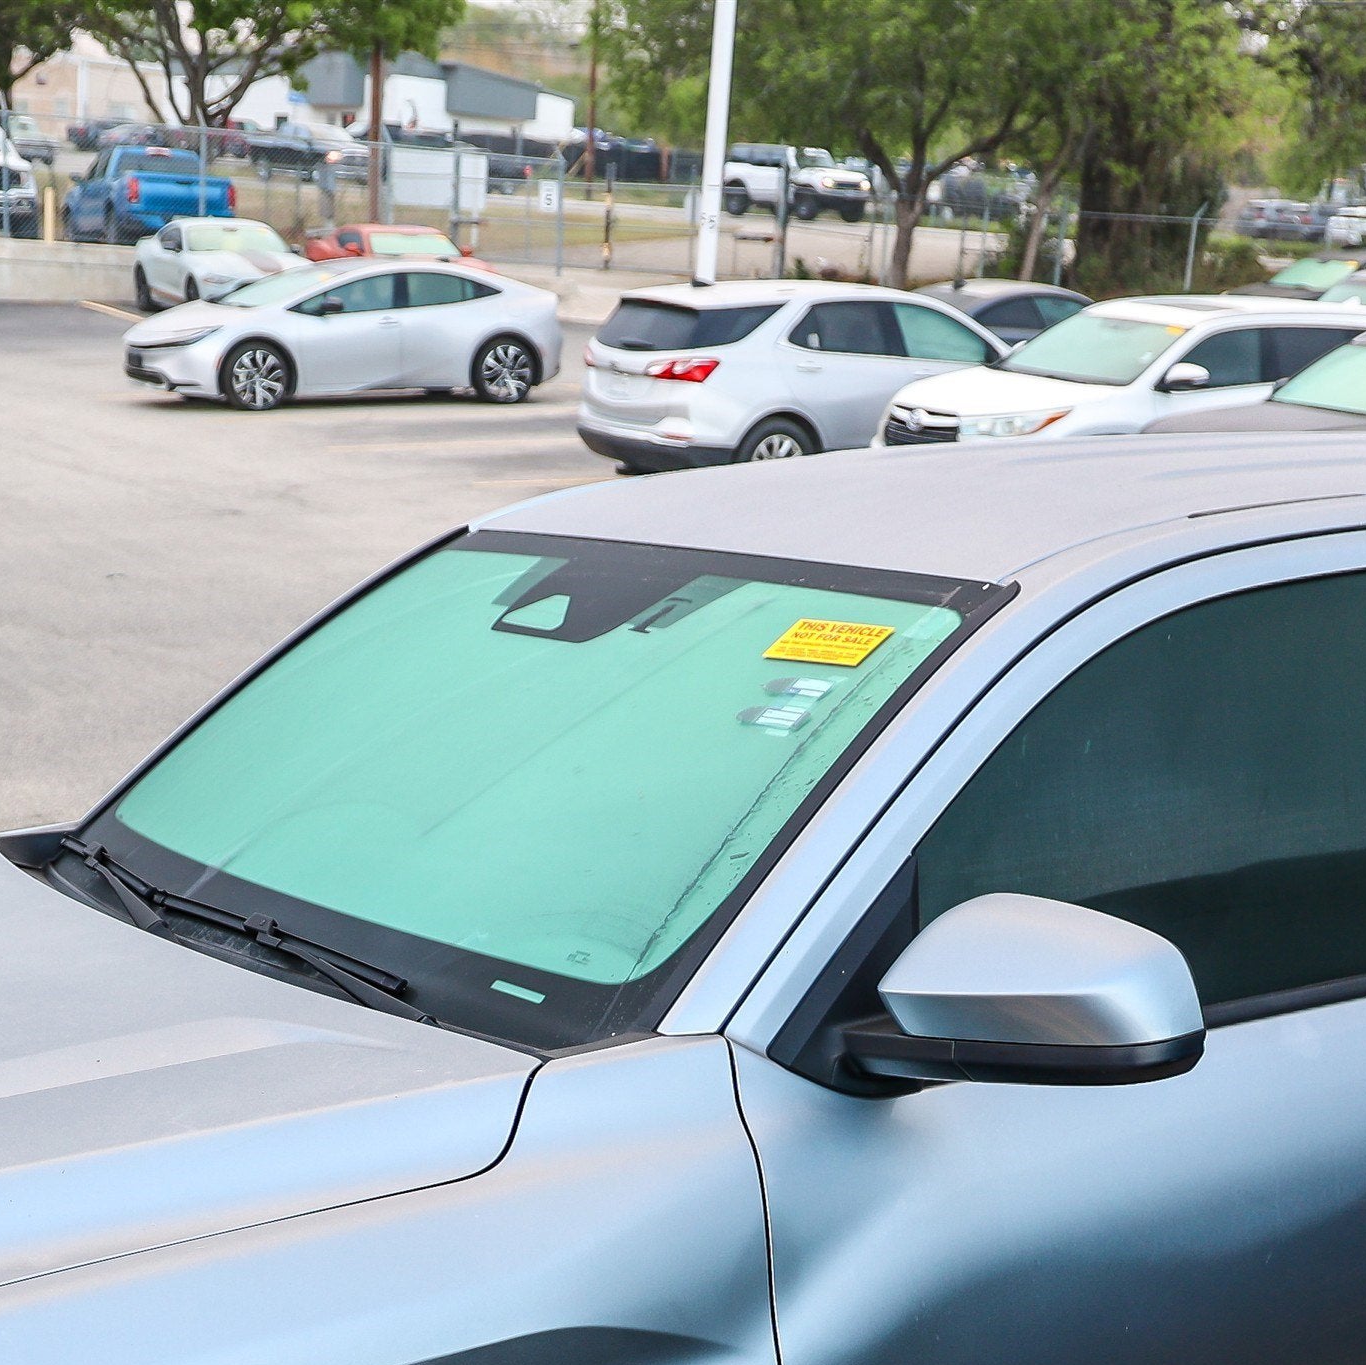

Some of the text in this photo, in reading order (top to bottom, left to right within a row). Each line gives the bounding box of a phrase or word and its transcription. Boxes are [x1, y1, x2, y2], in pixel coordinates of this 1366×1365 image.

[546, 193, 554, 206] 5
[798, 621, 888, 637] THIS VEHICLE
[791, 632, 814, 640] NOT
[815, 633, 841, 642] FOR
[841, 635, 875, 646] SALE
